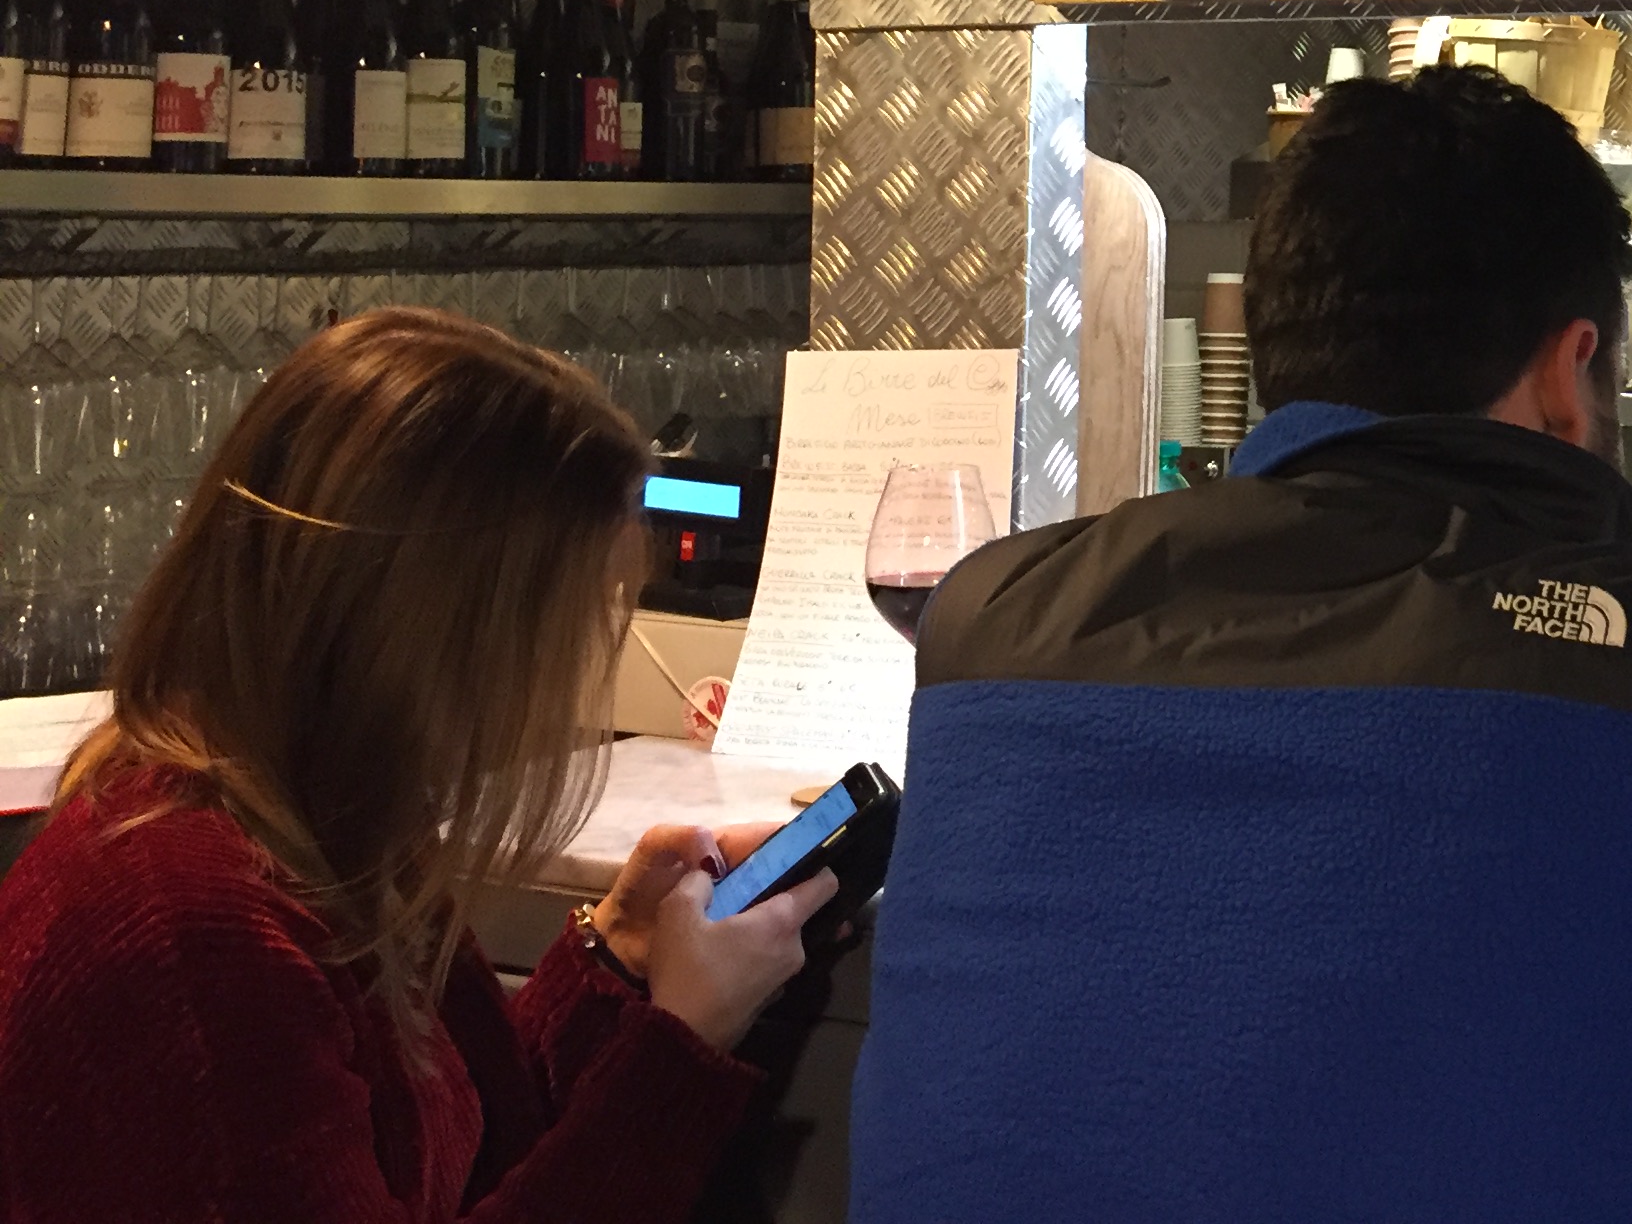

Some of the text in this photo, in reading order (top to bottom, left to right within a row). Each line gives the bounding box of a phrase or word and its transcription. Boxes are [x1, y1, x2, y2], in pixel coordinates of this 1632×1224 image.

[1538, 579, 1589, 604] THE
[1492, 592, 1584, 622] NORTH
[1513, 614, 1580, 640] FACE
